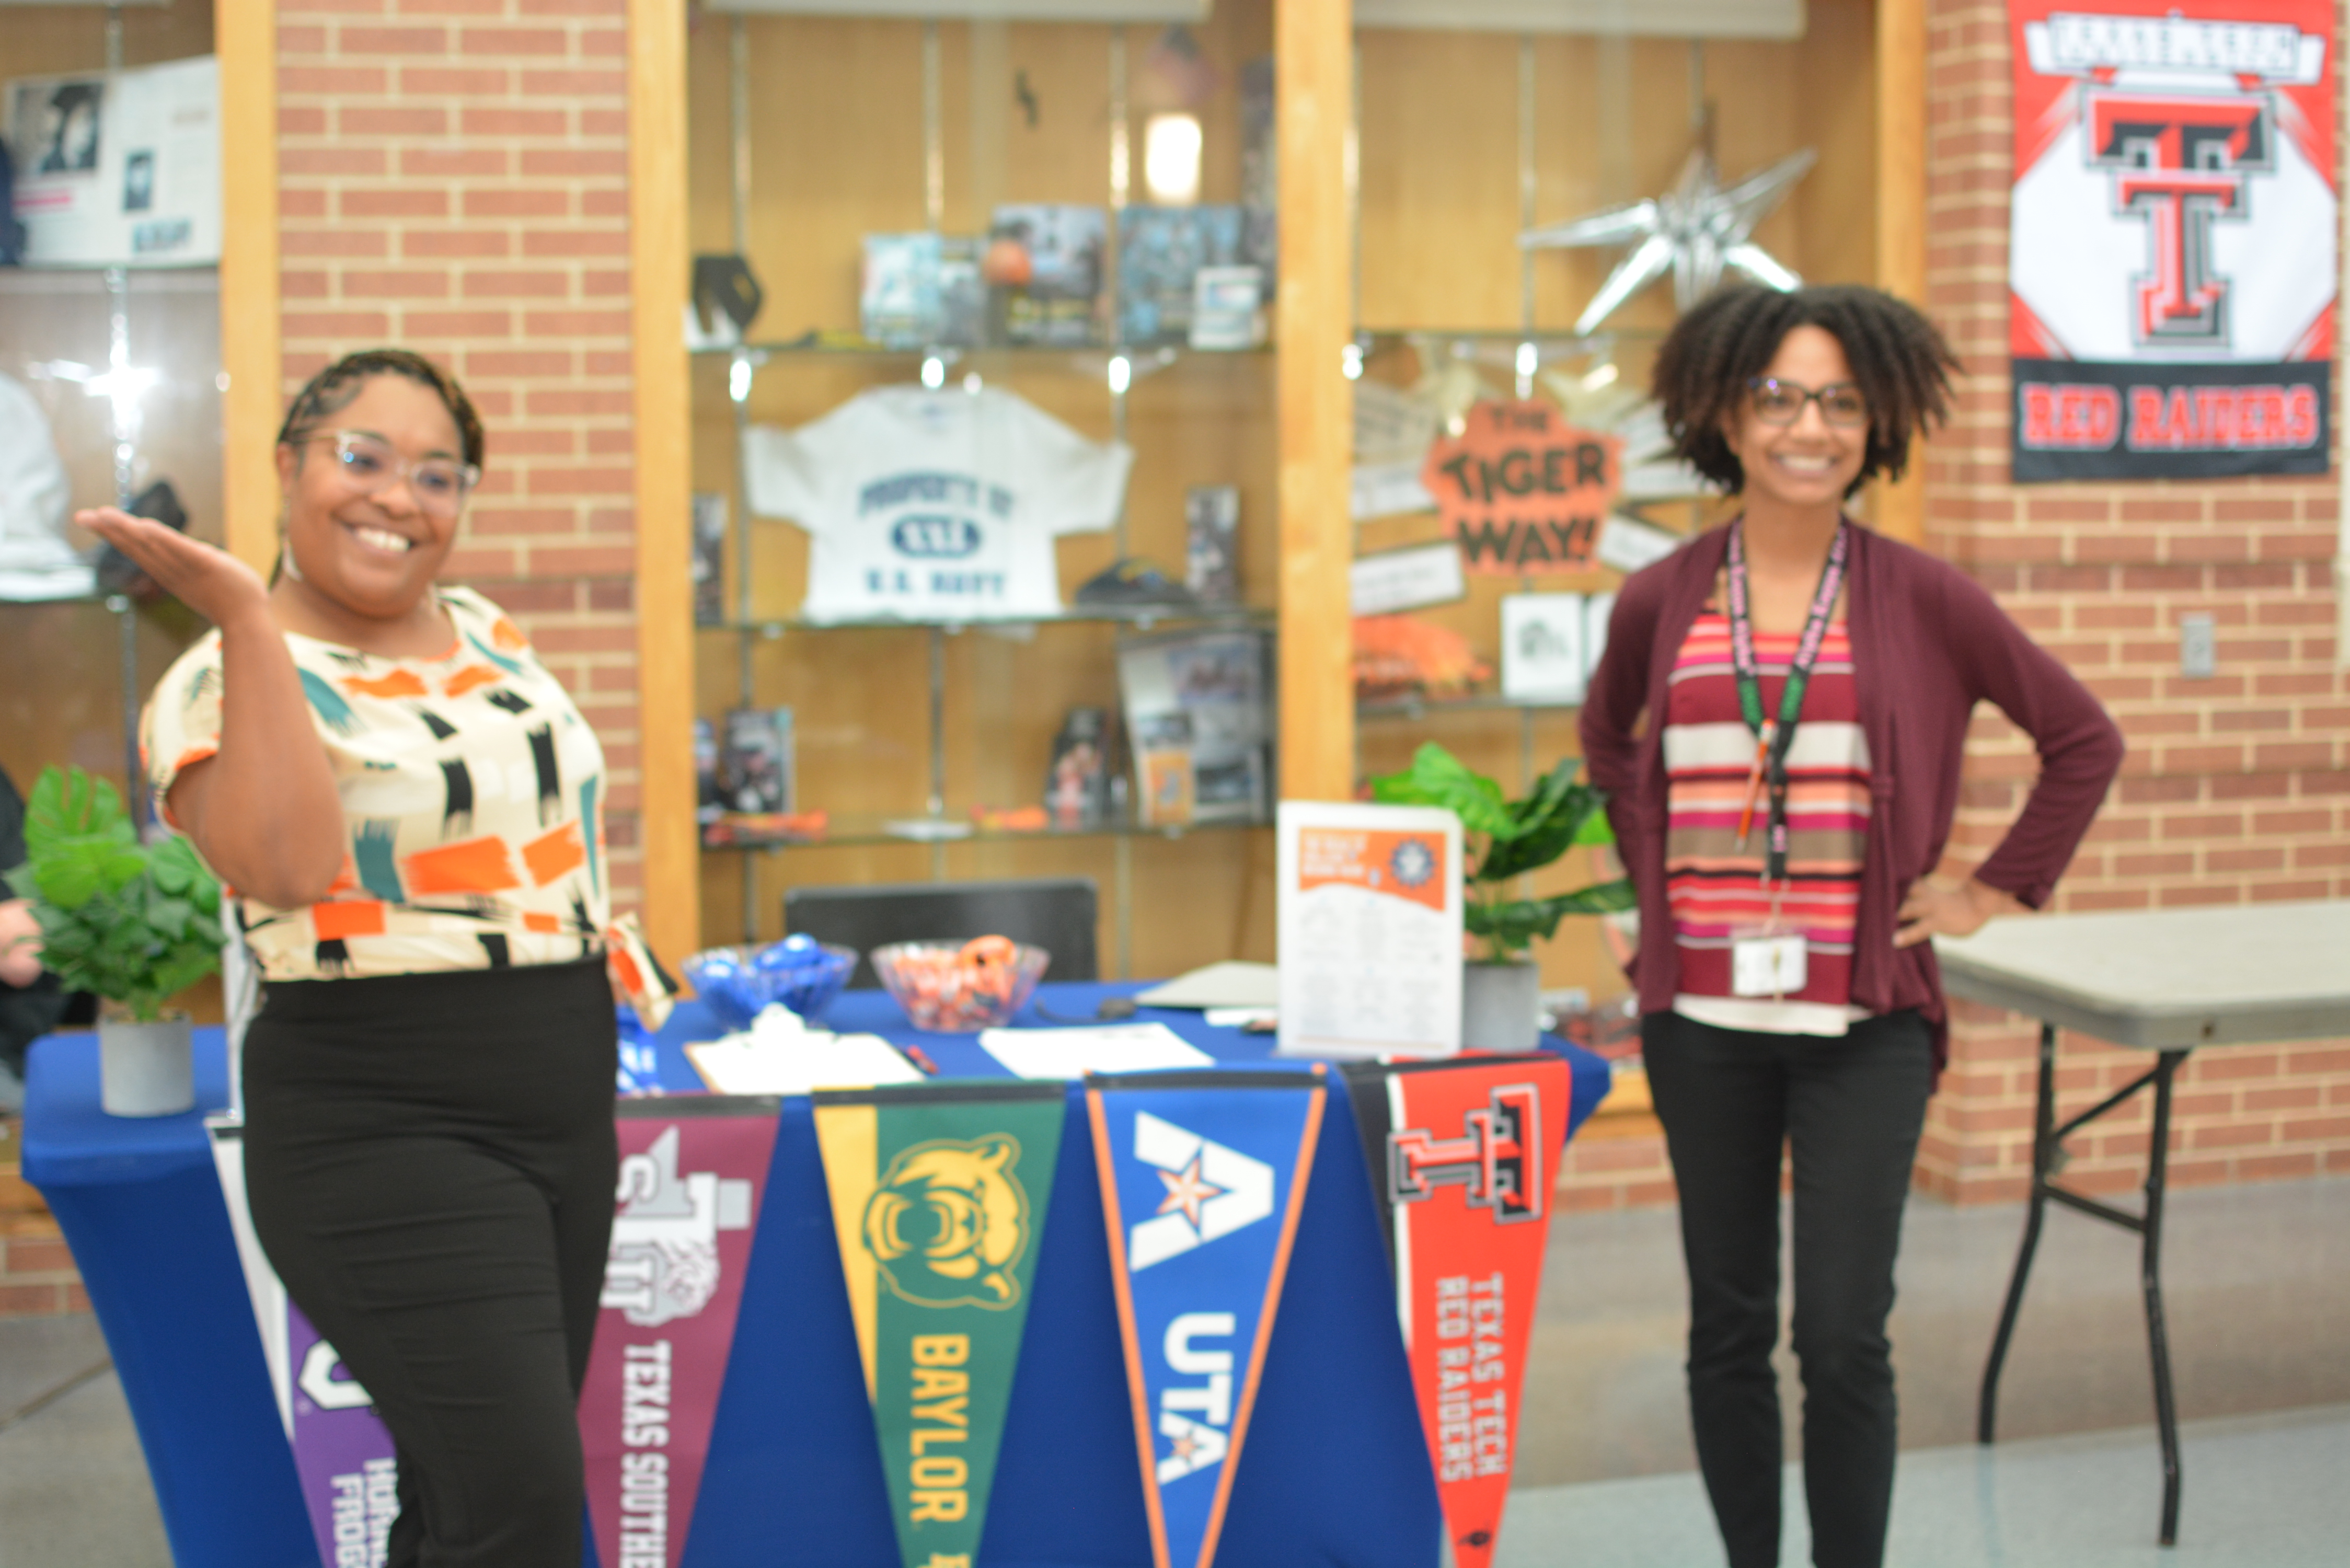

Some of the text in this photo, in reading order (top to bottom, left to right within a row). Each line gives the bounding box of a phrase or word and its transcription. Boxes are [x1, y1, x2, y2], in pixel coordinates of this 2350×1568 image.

[1439, 443, 1606, 504] TIGER
[2020, 384, 2319, 452] RED RAIDERS
[1457, 517, 1596, 564] WAY!
[622, 1339, 672, 1447] TEXAS
[910, 1334, 970, 1523] BAYLOR
[1156, 1311, 1236, 1485] UTA
[1435, 1275, 1474, 1482] RED RAIDERS
[1471, 1271, 1508, 1477] TEXAS TECH
